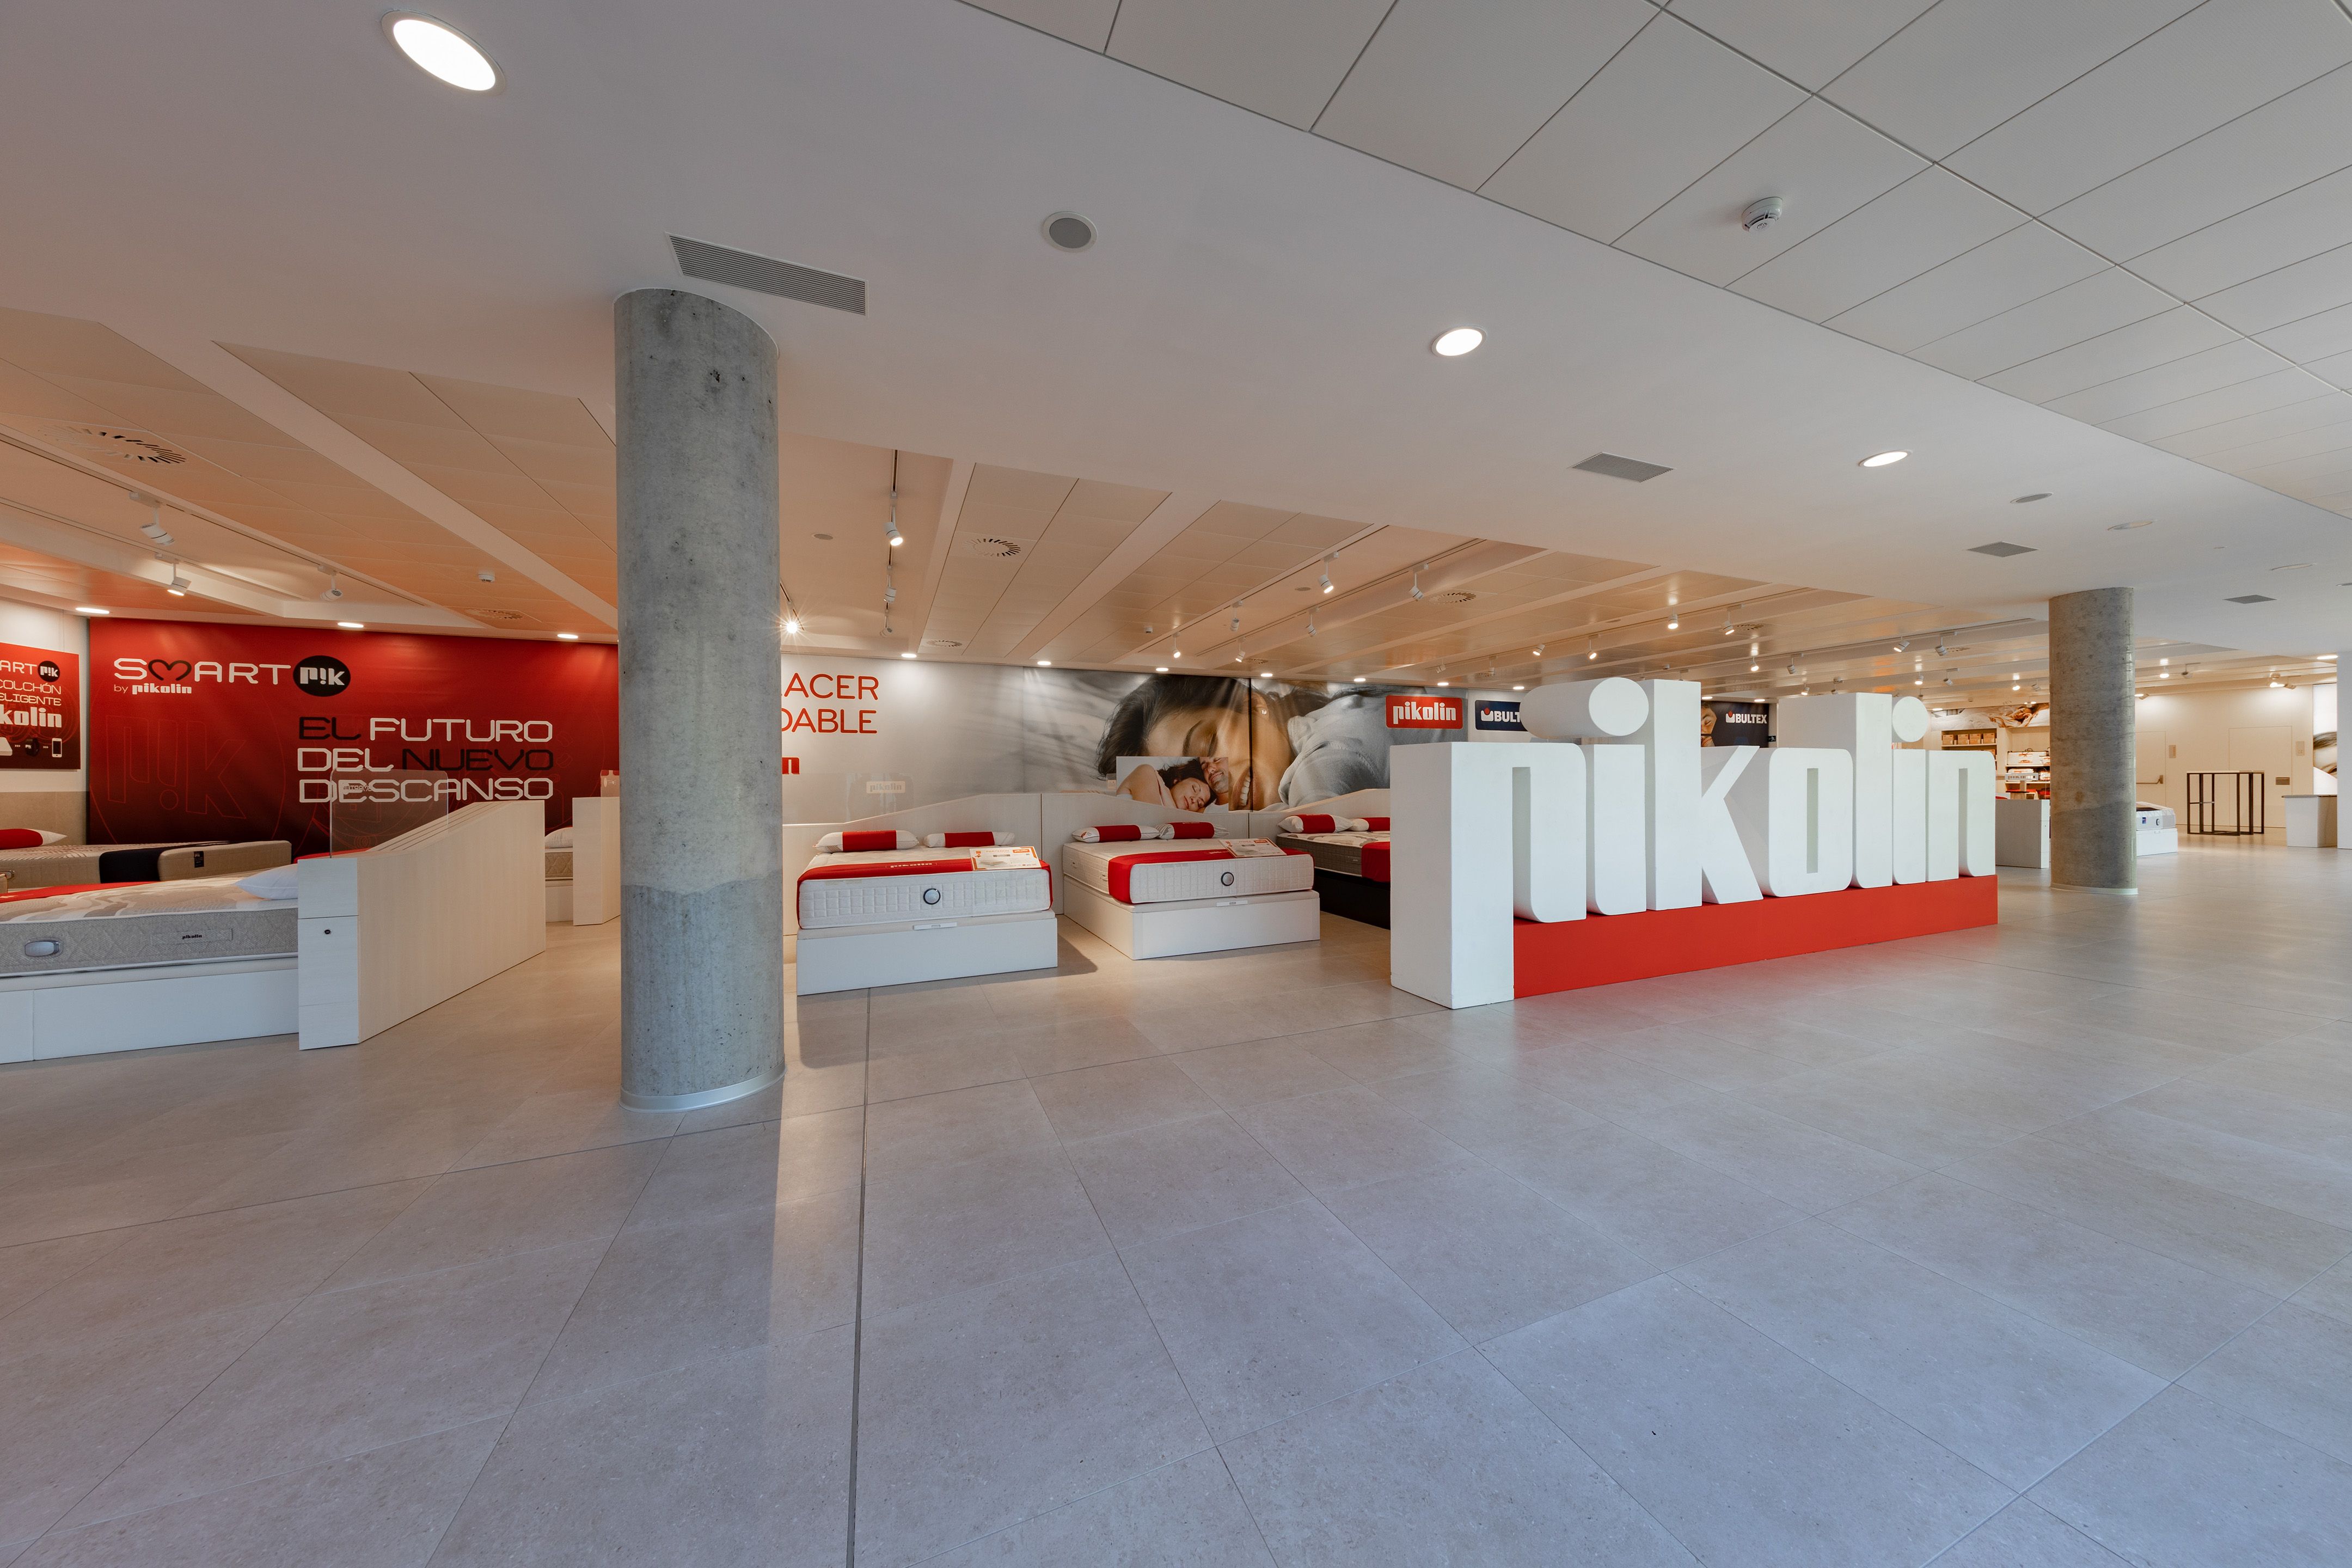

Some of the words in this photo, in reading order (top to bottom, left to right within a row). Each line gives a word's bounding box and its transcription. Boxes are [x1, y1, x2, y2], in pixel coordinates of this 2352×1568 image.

[0, 679, 61, 694] OLCHÓN
[114, 684, 128, 694] by
[132, 683, 192, 695] pikolin
[781, 672, 879, 700] ACER
[1393, 701, 1456, 724] pikolin
[1494, 710, 1520, 722] BULT
[1736, 714, 1767, 724] BULTEX
[299, 716, 362, 740] EL
[370, 718, 553, 742] FUTURO
[298, 748, 394, 771] DEL
[402, 749, 553, 771] NUEVO
[299, 778, 553, 803] DESCANSO
[870, 783, 902, 792] pikolin
[1390, 677, 1996, 1007] pikolin
